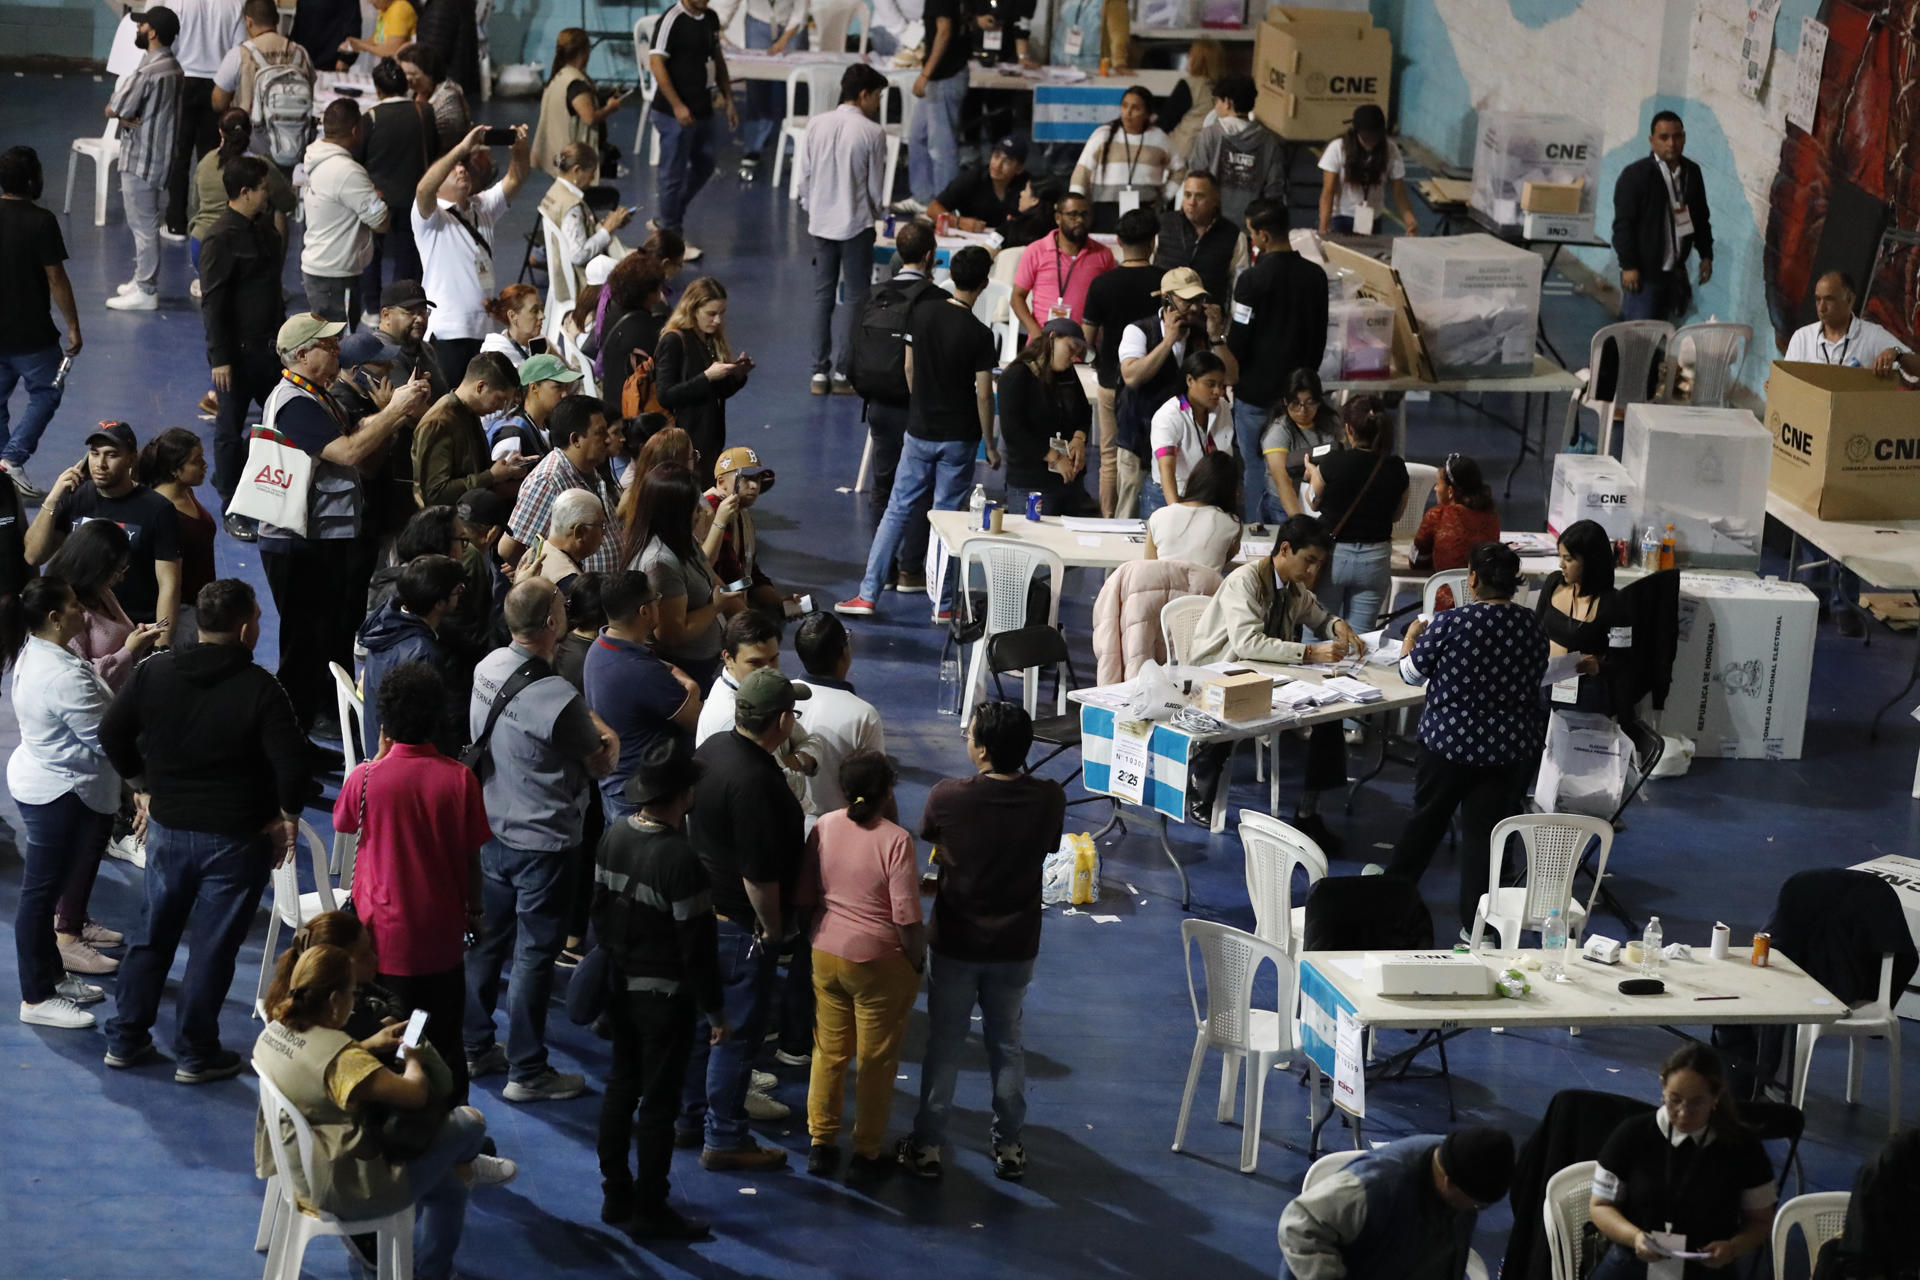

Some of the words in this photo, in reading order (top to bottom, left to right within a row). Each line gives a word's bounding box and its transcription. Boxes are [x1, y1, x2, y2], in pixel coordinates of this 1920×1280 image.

[1329, 75, 1377, 94] CNE
[1545, 143, 1588, 160] CNE
[1781, 422, 1813, 456] CNE
[1874, 438, 1920, 462] CN
[745, 449, 758, 463] B
[254, 465, 293, 489] ASJ
[1600, 494, 1627, 504] CNE
[1705, 622, 1716, 670] HONDURAS
[1772, 615, 1782, 662] ELECTORAL
[1703, 671, 1710, 682] DE
[1768, 664, 1777, 705] NACIONAL
[1763, 706, 1772, 741] ONSEJO
